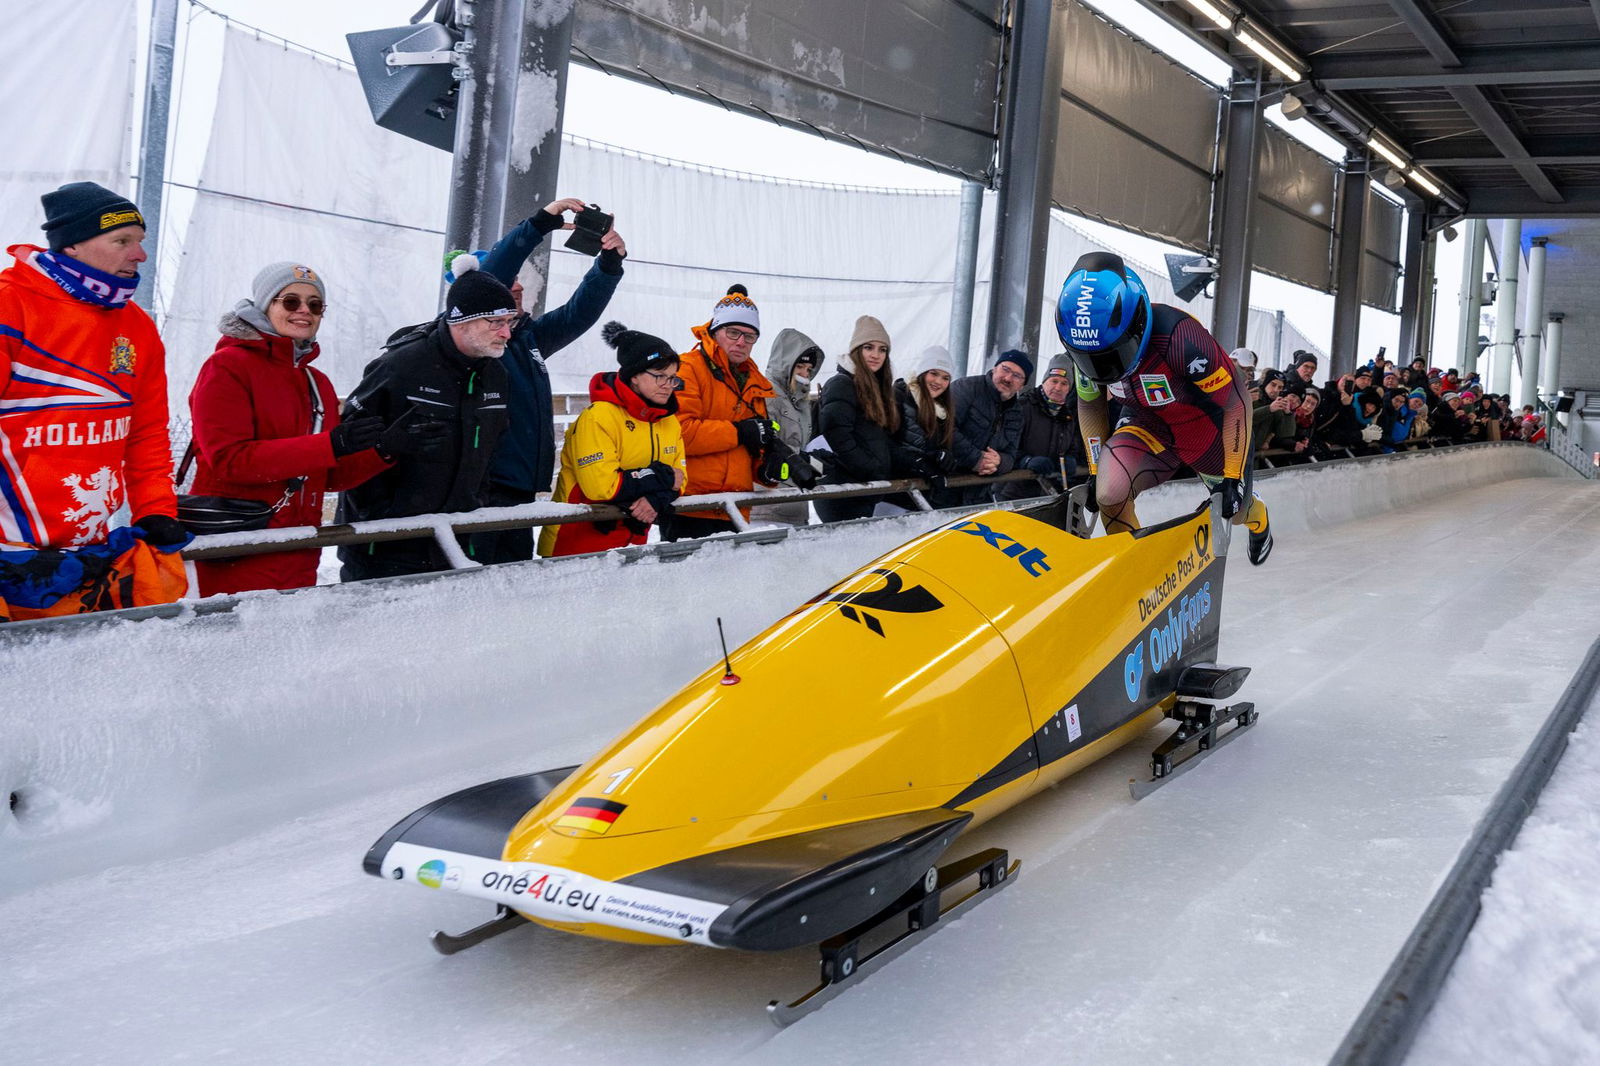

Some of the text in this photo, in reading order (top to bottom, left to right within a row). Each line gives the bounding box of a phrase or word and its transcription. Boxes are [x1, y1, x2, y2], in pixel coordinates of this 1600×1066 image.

[1076, 284, 1095, 328] BMW
[1070, 327, 1099, 339] BMW
[1072, 338, 1100, 346] helmets
[22, 415, 132, 448] HOLLAND
[1138, 549, 1195, 623] Deutsche Post
[1149, 581, 1211, 674] OnlyFans
[601, 767, 634, 794] 1
[482, 871, 601, 911] one4u.eu
